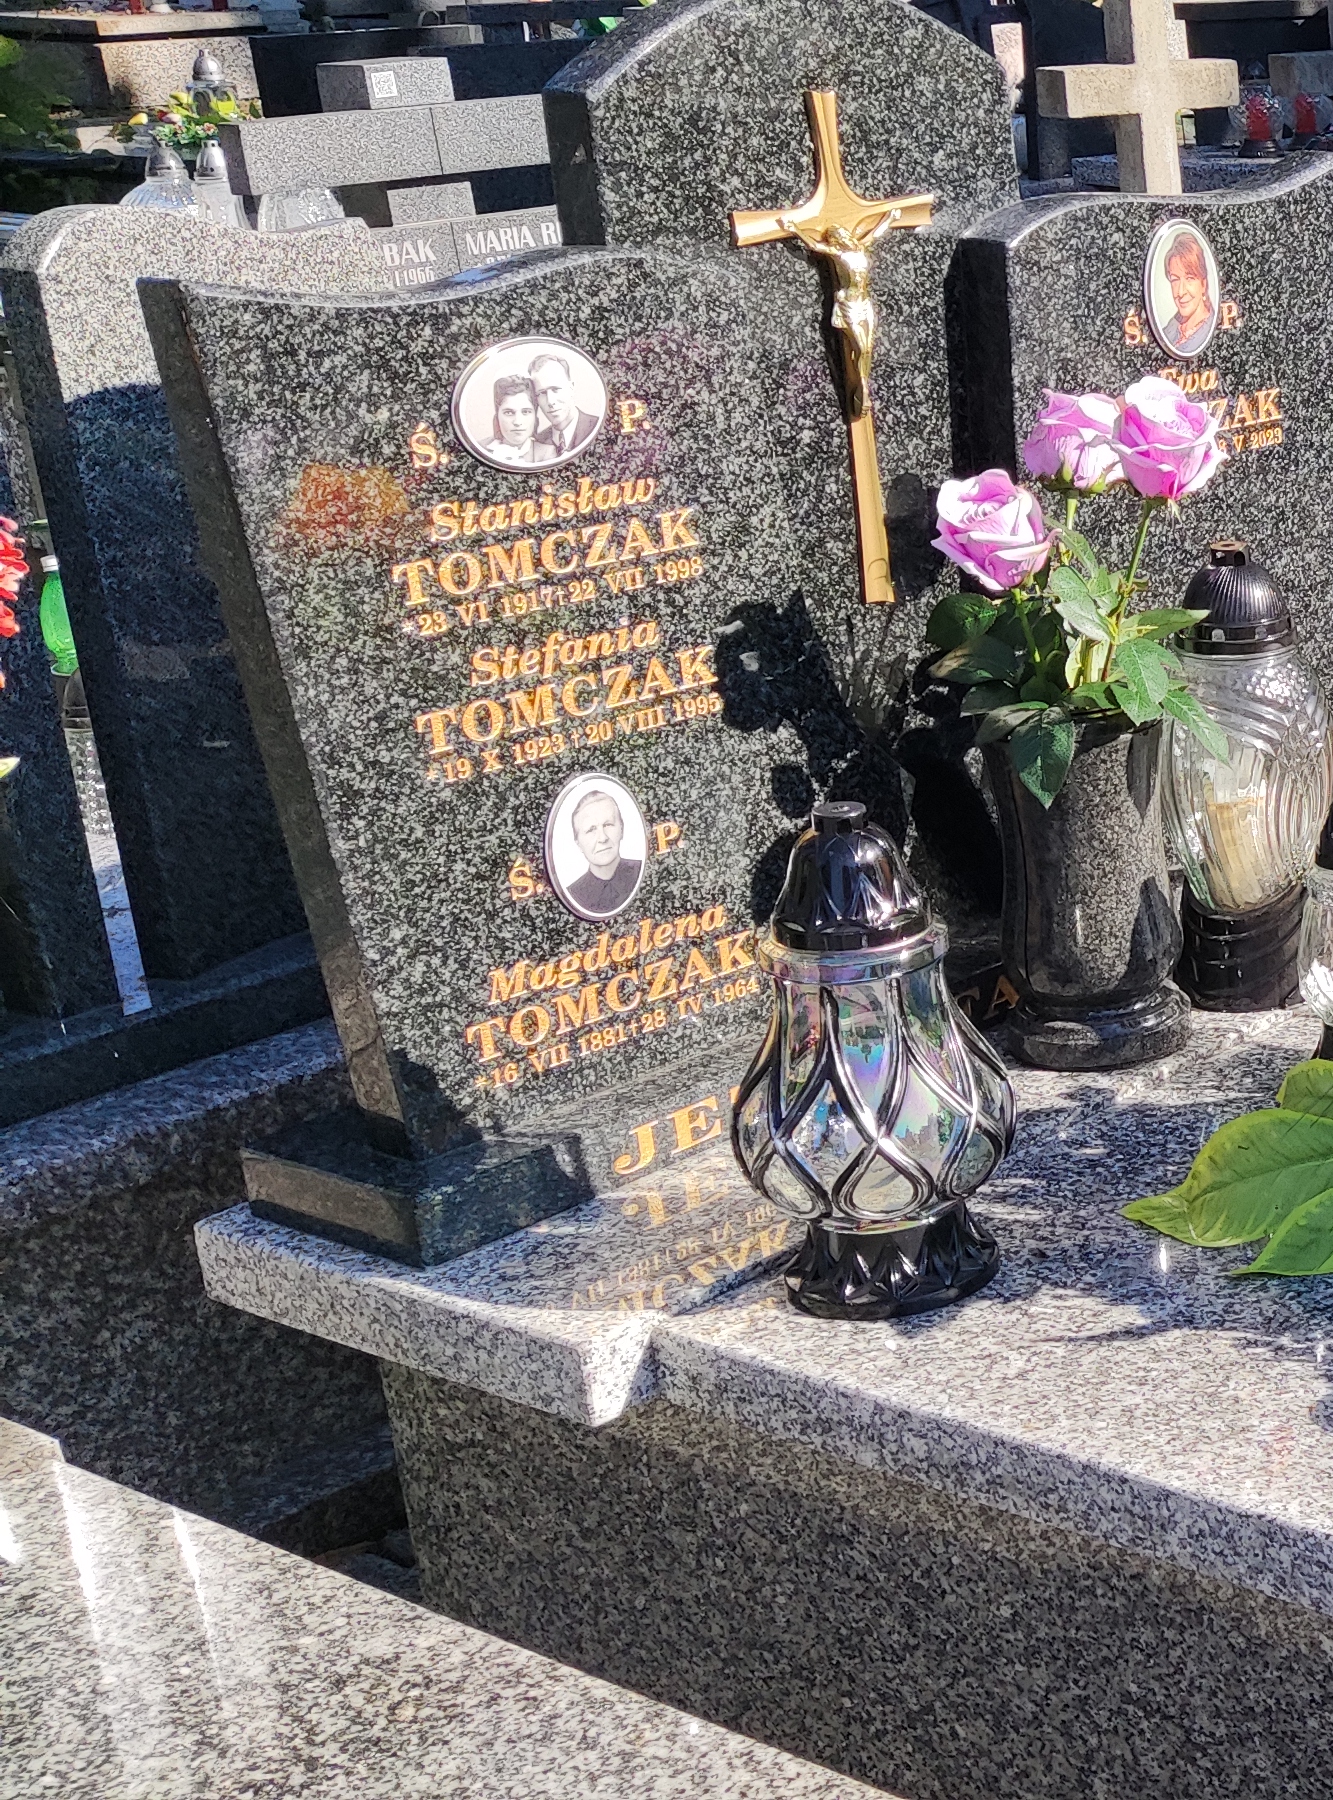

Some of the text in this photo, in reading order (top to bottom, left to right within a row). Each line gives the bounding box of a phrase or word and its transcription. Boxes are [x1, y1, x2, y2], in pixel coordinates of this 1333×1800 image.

[403, 266, 435, 286] 1966
[465, 225, 536, 255] MARIA
[410, 399, 651, 468] Ś. P.
[1250, 428, 1283, 449] 2023
[430, 476, 655, 542] Stanisław
[391, 507, 700, 606] TOMCZAK
[455, 601, 489, 627] VI
[603, 568, 643, 594] VII
[653, 556, 703, 584] 1998
[471, 617, 659, 687] Stefania
[415, 645, 718, 755] TOMCZAK
[481, 748, 502, 773] X
[512, 733, 566, 764] 1923
[616, 706, 666, 734] VIII
[673, 693, 722, 722] 1995
[508, 821, 685, 900] Ś. P.
[488, 904, 727, 1006] Magdalena
[466, 930, 756, 1063] TOMCZAK
[528, 1043, 571, 1072] VII
[677, 995, 703, 1019] IV
[712, 976, 760, 1007] 1964
[612, 1086, 740, 1174] JE
